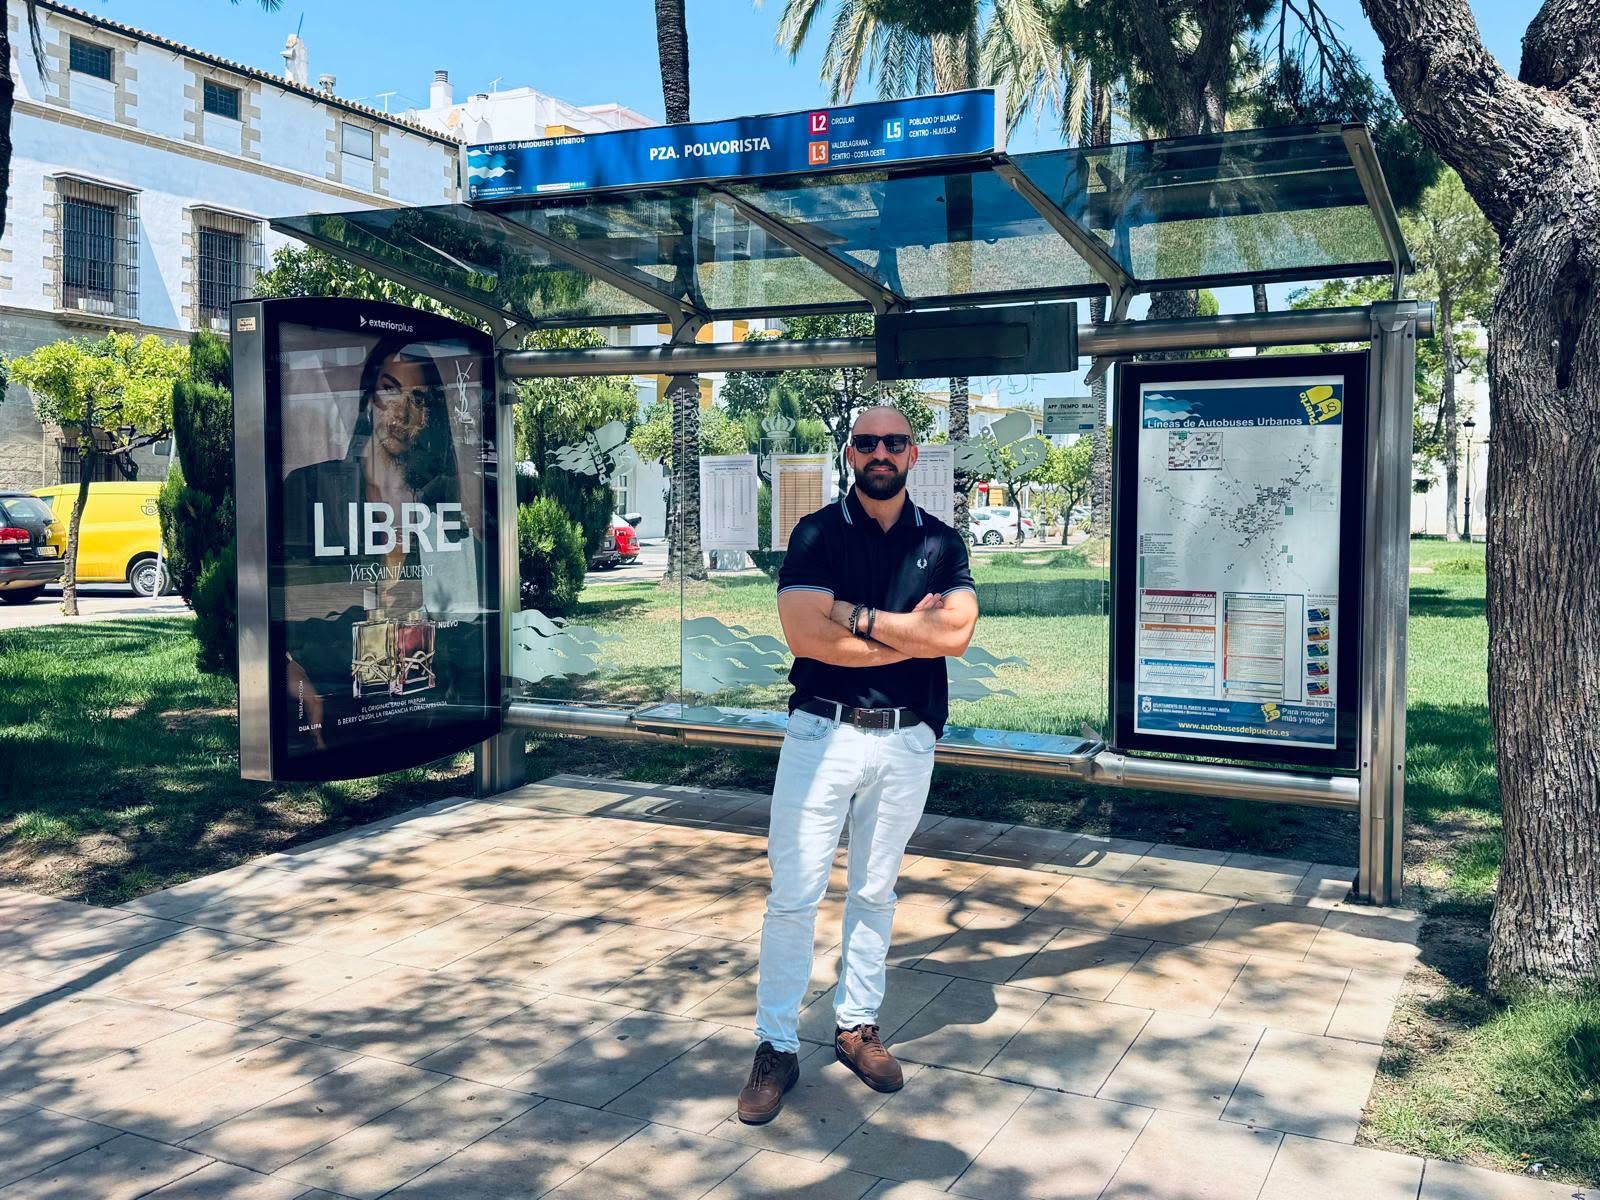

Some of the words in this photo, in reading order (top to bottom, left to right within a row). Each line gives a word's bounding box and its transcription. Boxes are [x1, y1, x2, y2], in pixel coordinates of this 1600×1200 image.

[812, 114, 826, 132] L2
[831, 116, 855, 126] CIRCULAR
[886, 121, 901, 139] L5
[908, 117, 933, 126] POBLADO
[940, 114, 960, 123] BLANCA
[908, 129, 929, 138] CENTRO
[933, 126, 956, 136] HIJUELAS
[507, 142, 516, 150] de
[517, 139, 554, 149] Autobuses
[555, 136, 586, 146] Urbanos
[649, 146, 680, 160] PZA.
[684, 136, 771, 158] POLVORISTA
[812, 144, 826, 161] L3
[831, 138, 868, 149] VALDELAGRANA
[831, 152, 850, 161] CENTRO
[853, 150, 869, 159] COSTA
[870, 148, 886, 157] OESTE
[369, 319, 414, 333] exteriorplus
[1184, 419, 1196, 428] de
[1198, 418, 1254, 428] Autobuses
[1257, 417, 1303, 426] Urbanos
[314, 502, 462, 557] LIBRE
[438, 621, 458, 629] NUEVO
[368, 702, 390, 712] ORIGINAL
[407, 697, 426, 706] PARFUM
[342, 716, 357, 725] BERRY
[382, 706, 409, 717] FRAGANCIA
[1300, 710, 1329, 718] moverte
[1304, 716, 1325, 725] mejor
[298, 724, 310, 732] DUA
[310, 722, 323, 730] LIPA
[1178, 722, 1290, 737] www.autobusesdelpuerto.es
